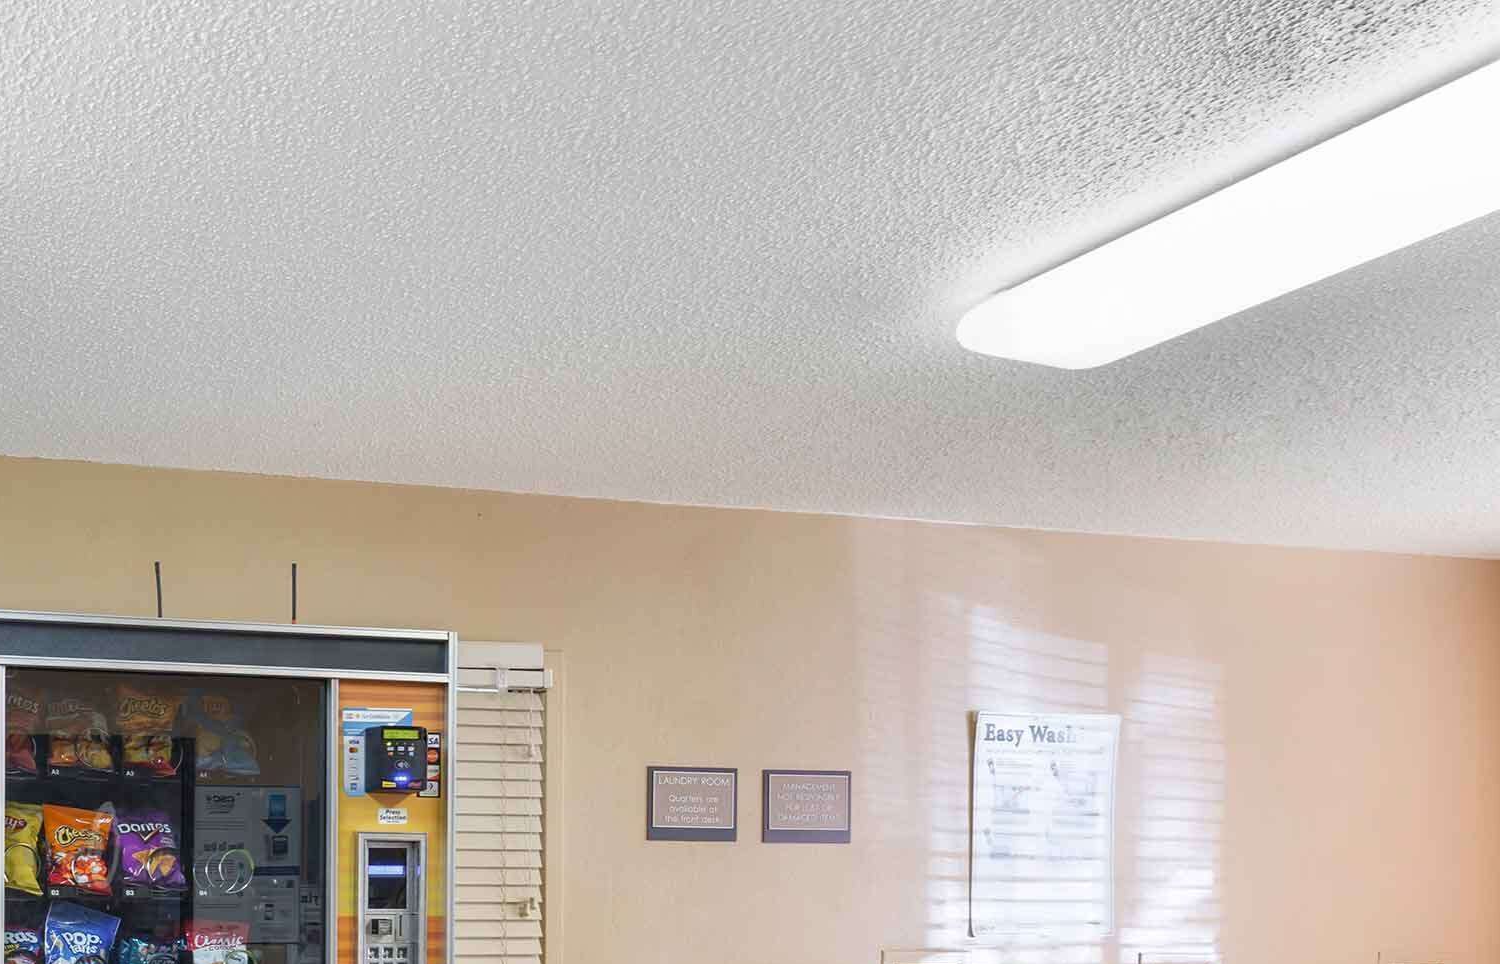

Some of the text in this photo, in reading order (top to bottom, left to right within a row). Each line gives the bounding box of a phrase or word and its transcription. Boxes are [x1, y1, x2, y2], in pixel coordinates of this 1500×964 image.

[984, 723, 1024, 747] Easy
[659, 776, 729, 786] LAUNDRY ROOM
[56, 825, 102, 846] Cheetos
[117, 822, 172, 834] Doritos
